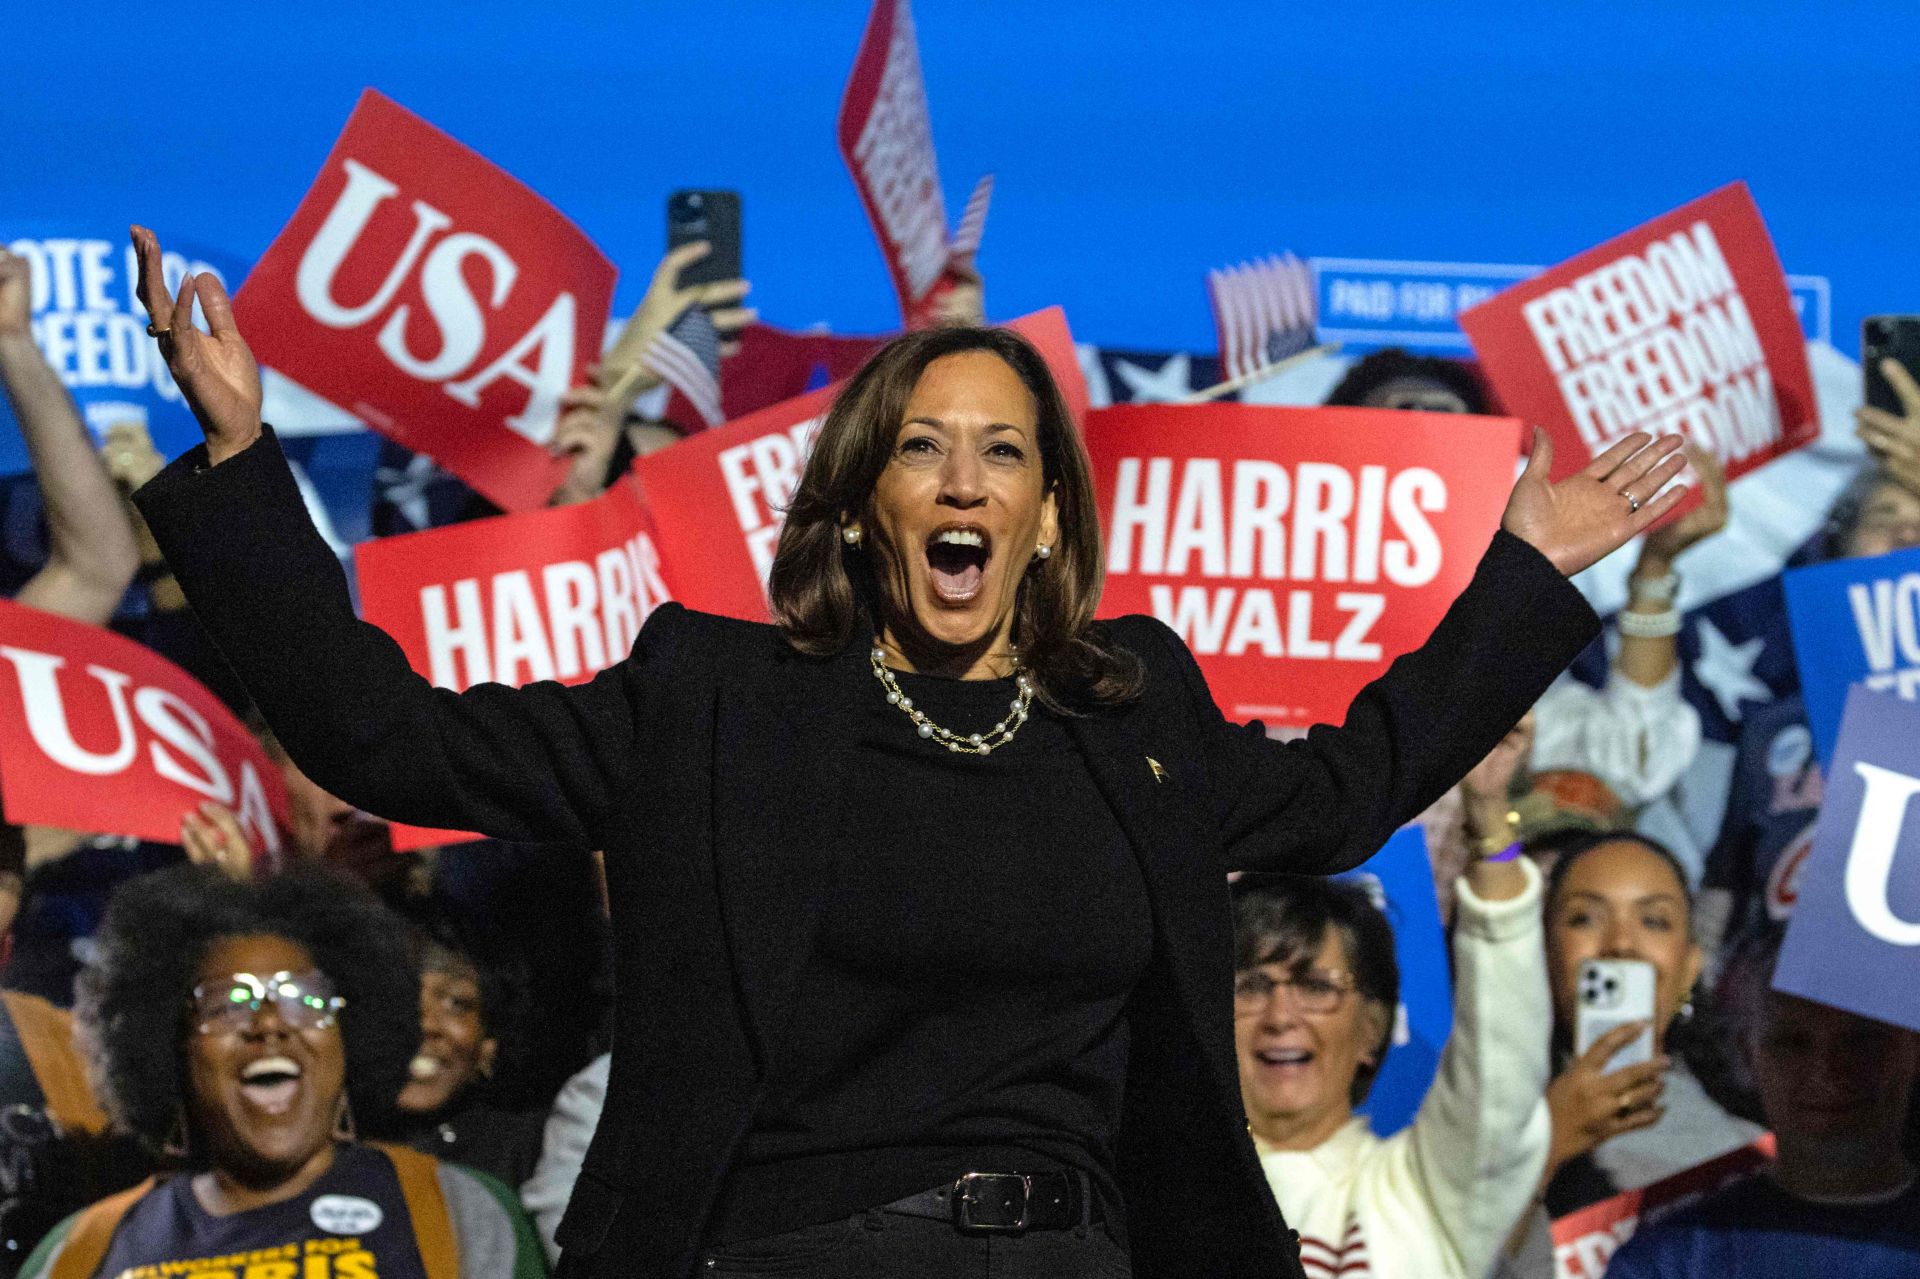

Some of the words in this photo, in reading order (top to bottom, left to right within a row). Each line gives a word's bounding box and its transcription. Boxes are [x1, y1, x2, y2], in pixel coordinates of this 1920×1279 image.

[8, 238, 117, 313] OTE
[295, 158, 577, 446] USA
[1522, 219, 1738, 375] FREEDOM
[1559, 293, 1766, 447] FREEDOM
[1107, 457, 1448, 588] HARRIS
[1149, 585, 1387, 662] WALZ
[0, 645, 282, 875] USA
